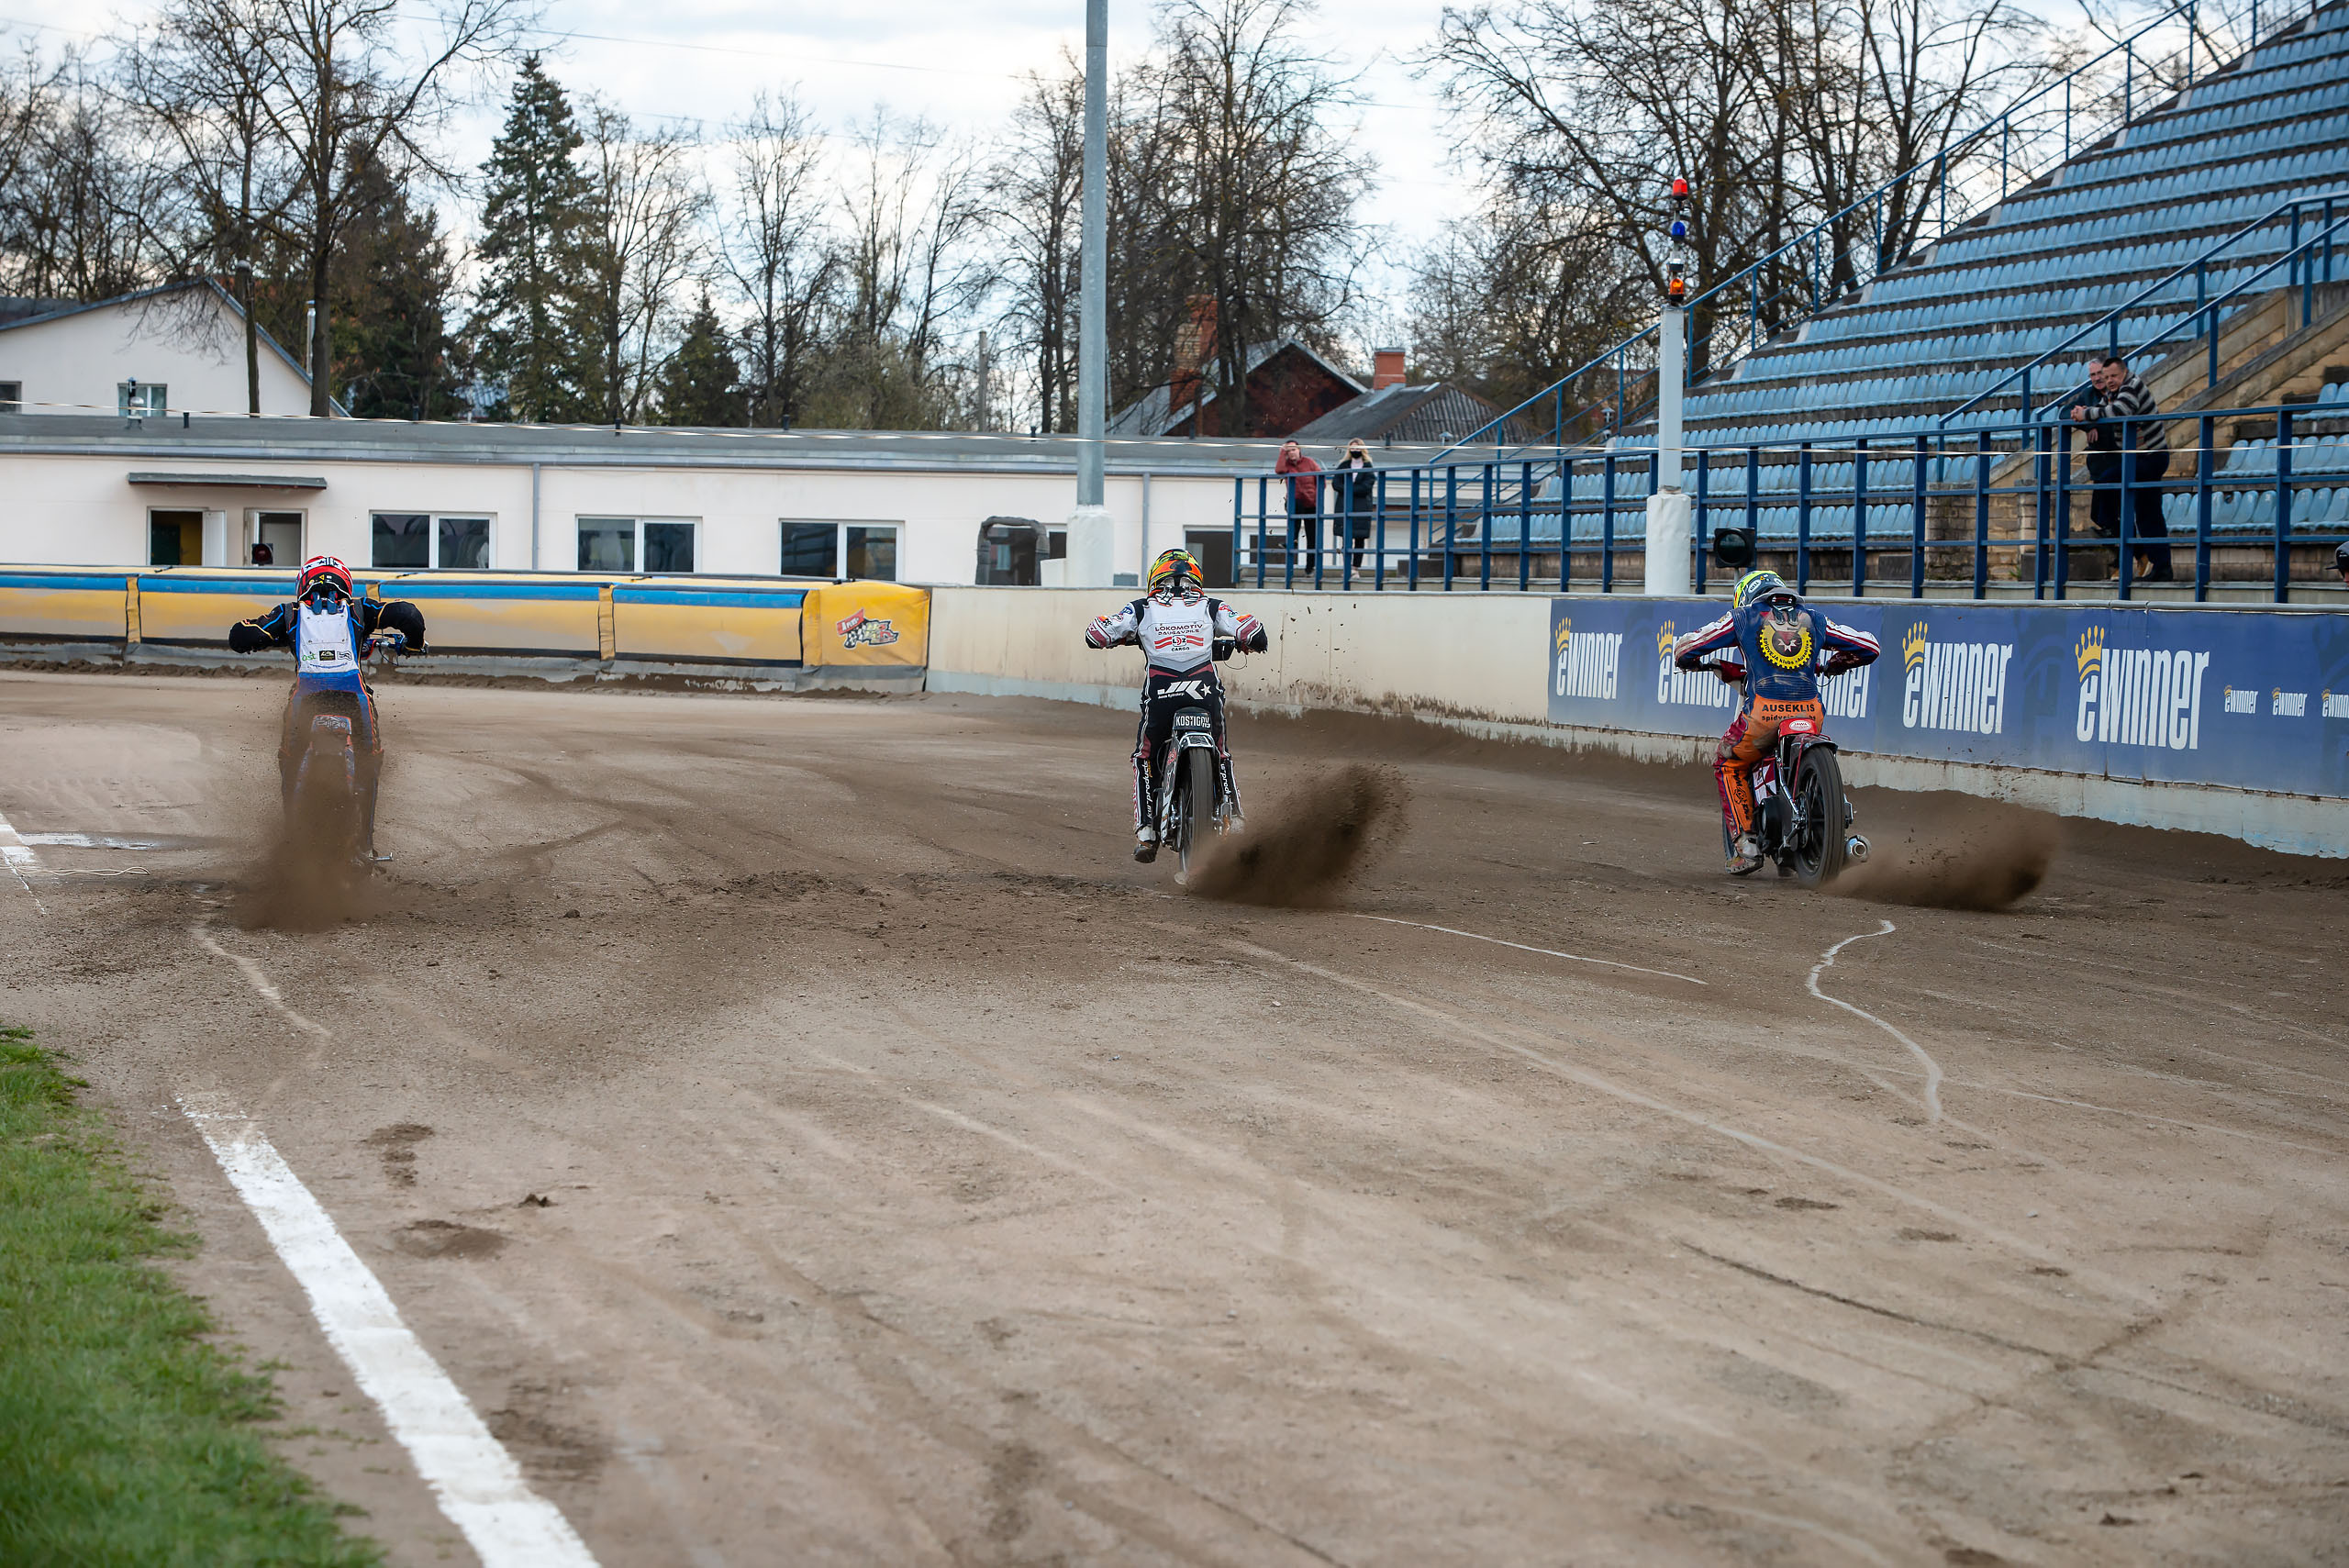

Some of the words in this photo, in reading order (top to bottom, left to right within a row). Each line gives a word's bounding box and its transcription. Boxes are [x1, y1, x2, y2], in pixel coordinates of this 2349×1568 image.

[1154, 624, 1203, 632] LOKOMOTIV
[1762, 704, 1815, 713] AUSEKLIS
[1175, 716, 1210, 727] KOSTIGOV
